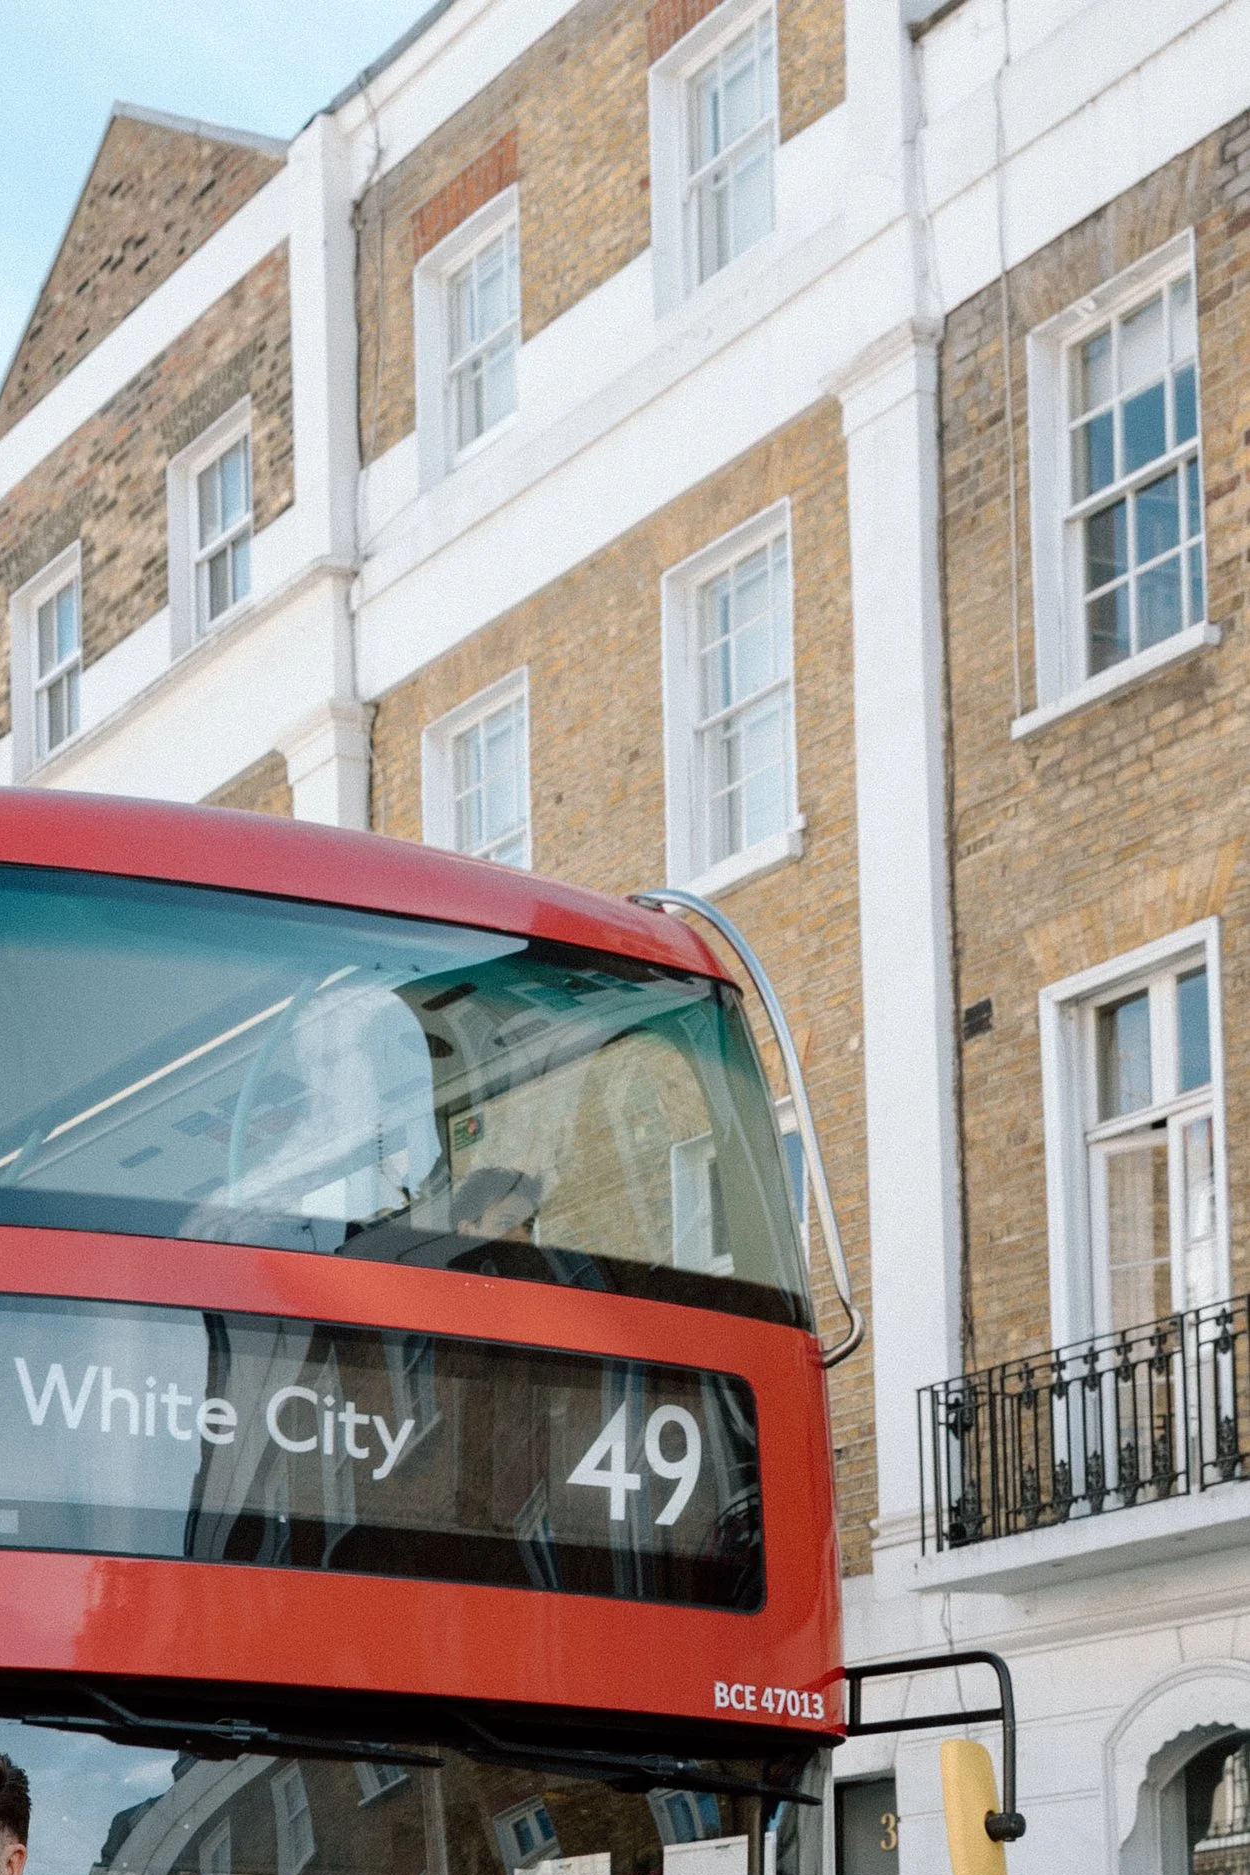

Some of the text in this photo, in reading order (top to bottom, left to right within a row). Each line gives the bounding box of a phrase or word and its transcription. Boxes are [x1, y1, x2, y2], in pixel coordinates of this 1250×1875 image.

[14, 1357, 702, 1526] White City 49
[714, 1680, 825, 1720] BCE 47013
